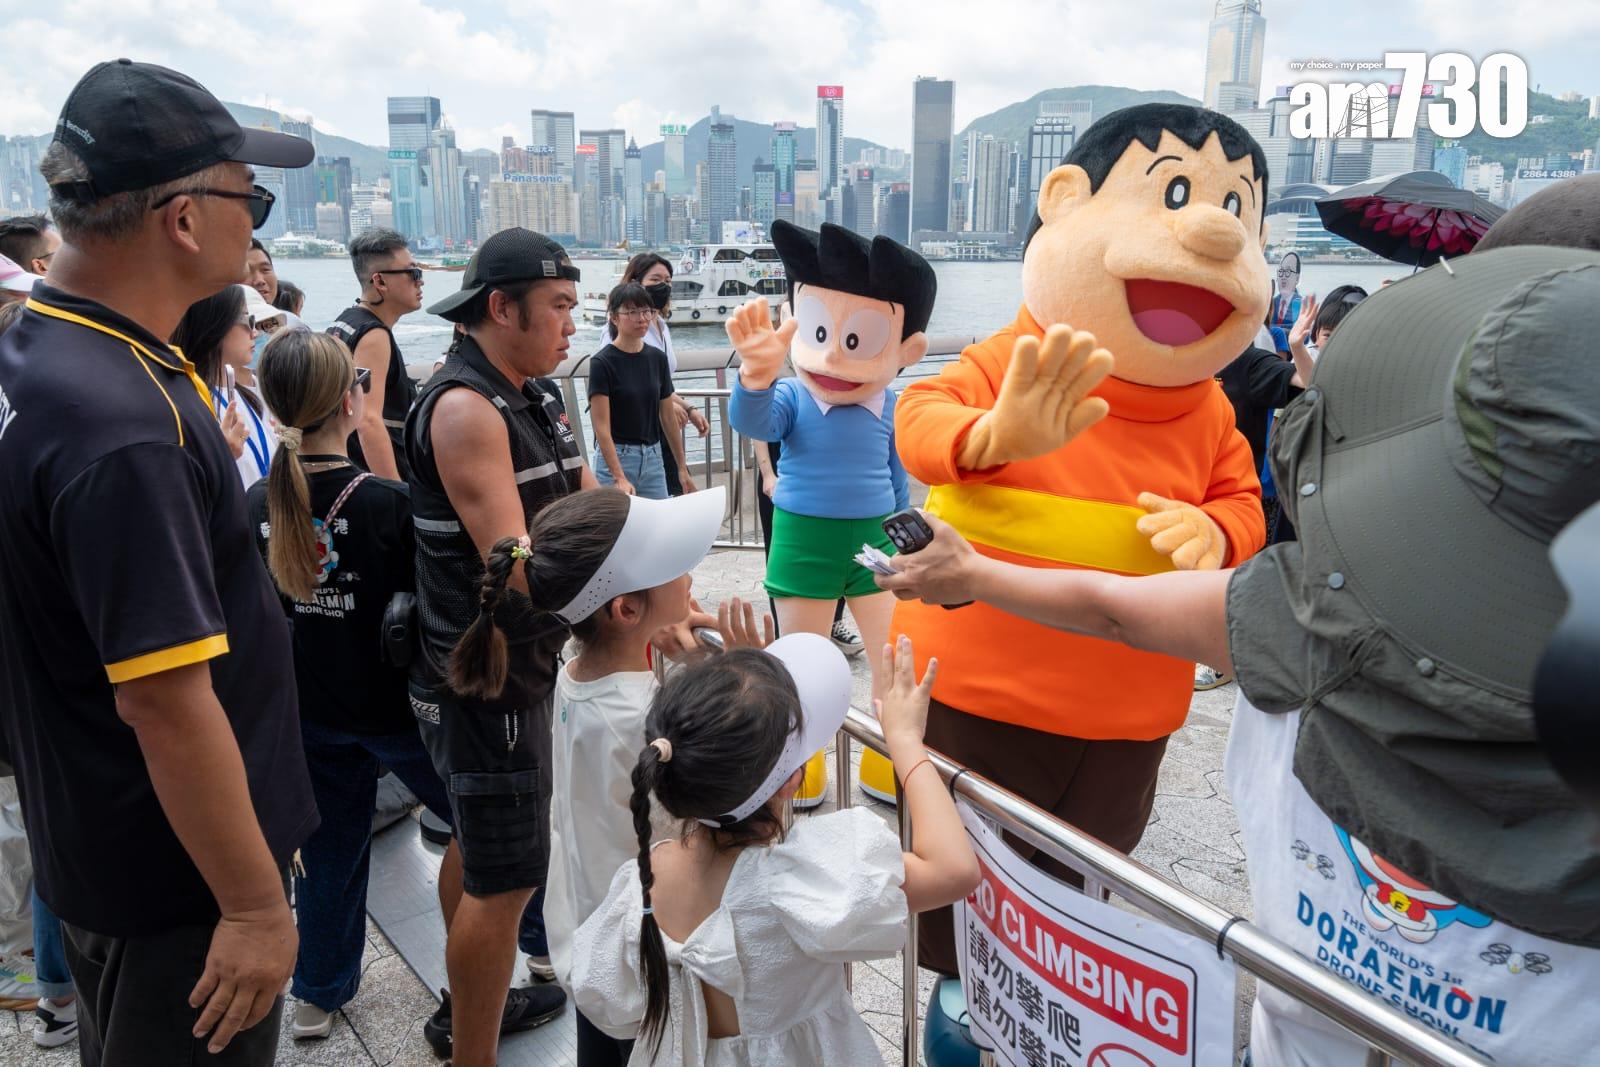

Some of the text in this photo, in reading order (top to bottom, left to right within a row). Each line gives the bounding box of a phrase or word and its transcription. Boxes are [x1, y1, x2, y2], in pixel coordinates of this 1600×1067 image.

[503, 173, 563, 183] Panasonic
[969, 920, 1082, 1058] 請勿攀爬
[1002, 899, 1180, 1040] CLIMBING
[1297, 890, 1508, 1035] DORAEMON
[1342, 908, 1463, 986] THE WORLD'S 1st
